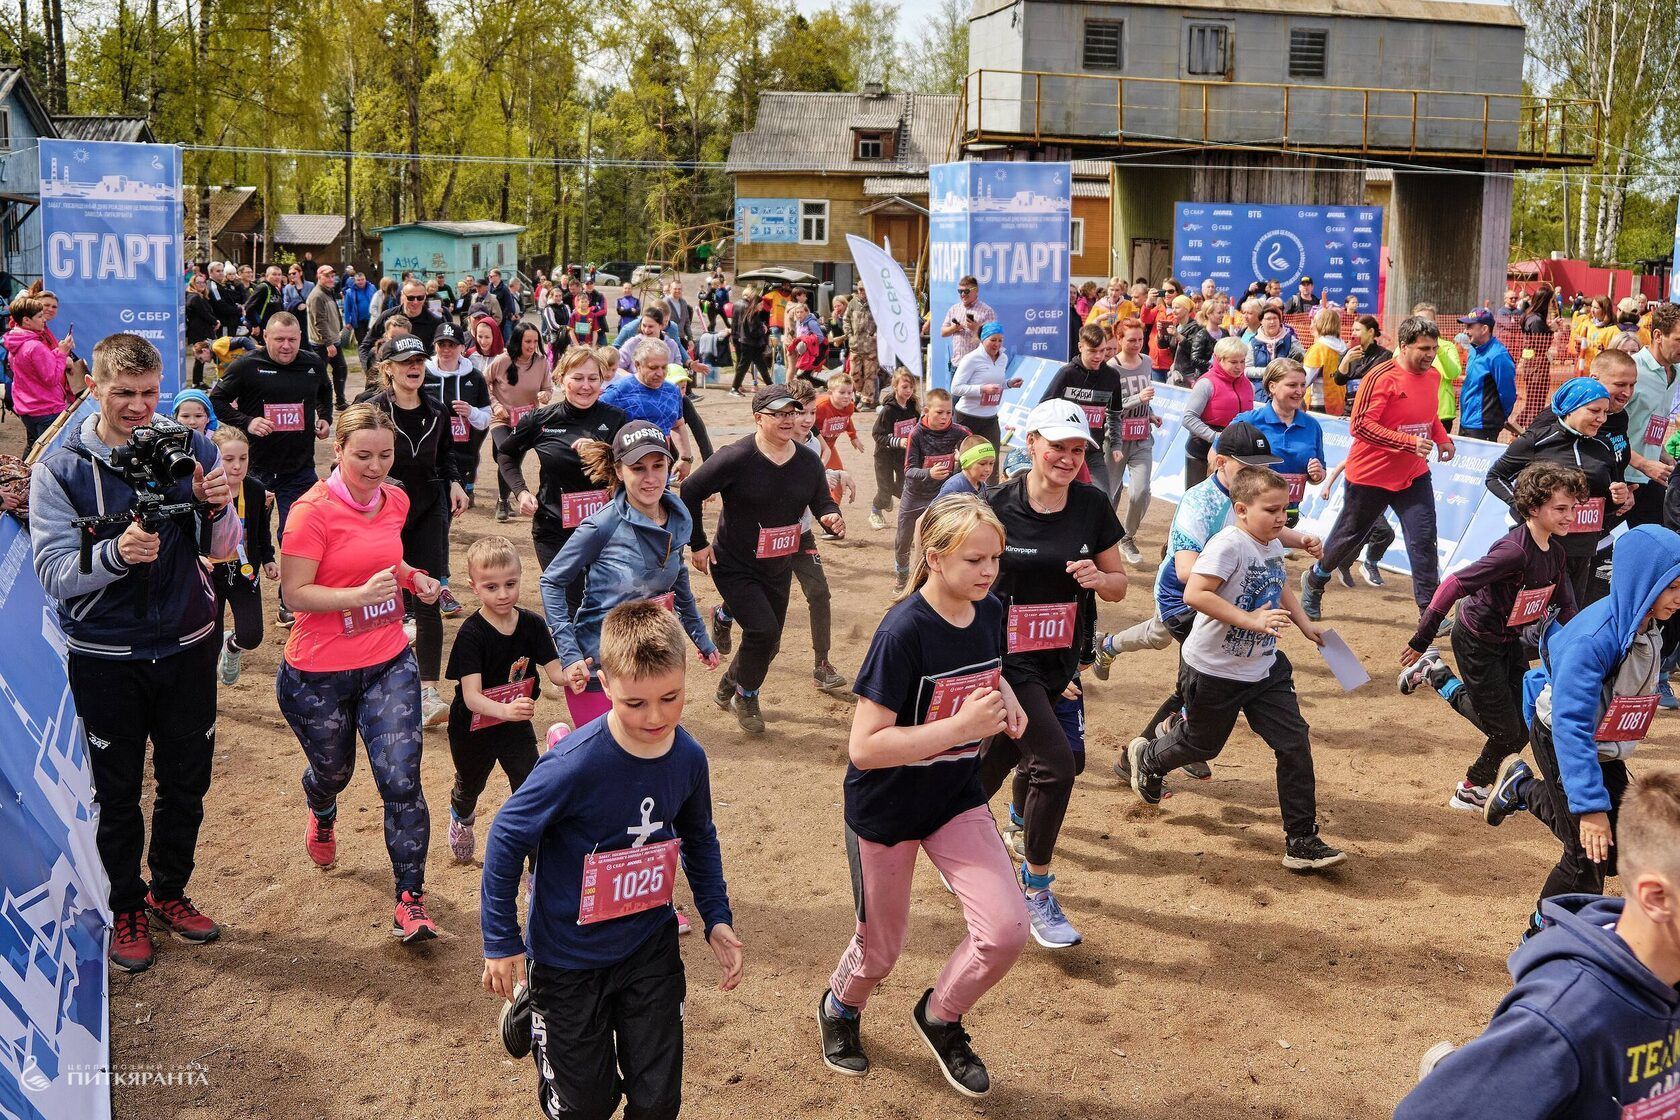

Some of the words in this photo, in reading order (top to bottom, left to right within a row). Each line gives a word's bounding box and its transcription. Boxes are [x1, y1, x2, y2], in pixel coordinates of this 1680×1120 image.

[1247, 210, 1262, 218] ВТБ
[1360, 212, 1373, 220] ВТБ
[1188, 239, 1203, 247] ВТБ
[48, 231, 173, 280] СТАРТ
[1330, 257, 1343, 265] ВТБ
[932, 242, 967, 282] СТАРТ
[973, 242, 1067, 284] СТАРТ
[137, 312, 171, 320] СБЕР
[1038, 310, 1064, 318] СБЕР
[443, 325, 455, 336] LA
[1025, 326, 1059, 335] ANDRITZ
[396, 338, 425, 352] HOCKEY
[1032, 342, 1048, 350] ВТБ
[1071, 388, 1093, 399] Kappa
[276, 413, 300, 425] 1124
[1129, 425, 1145, 435] 1107
[623, 428, 666, 446] CrossFit
[1577, 509, 1599, 525] 1003
[772, 534, 796, 550] 1031
[1005, 545, 1038, 555] Kirovpaper
[1028, 619, 1065, 639] 1101
[1616, 711, 1649, 731] 1081
[612, 865, 665, 902] 1025
